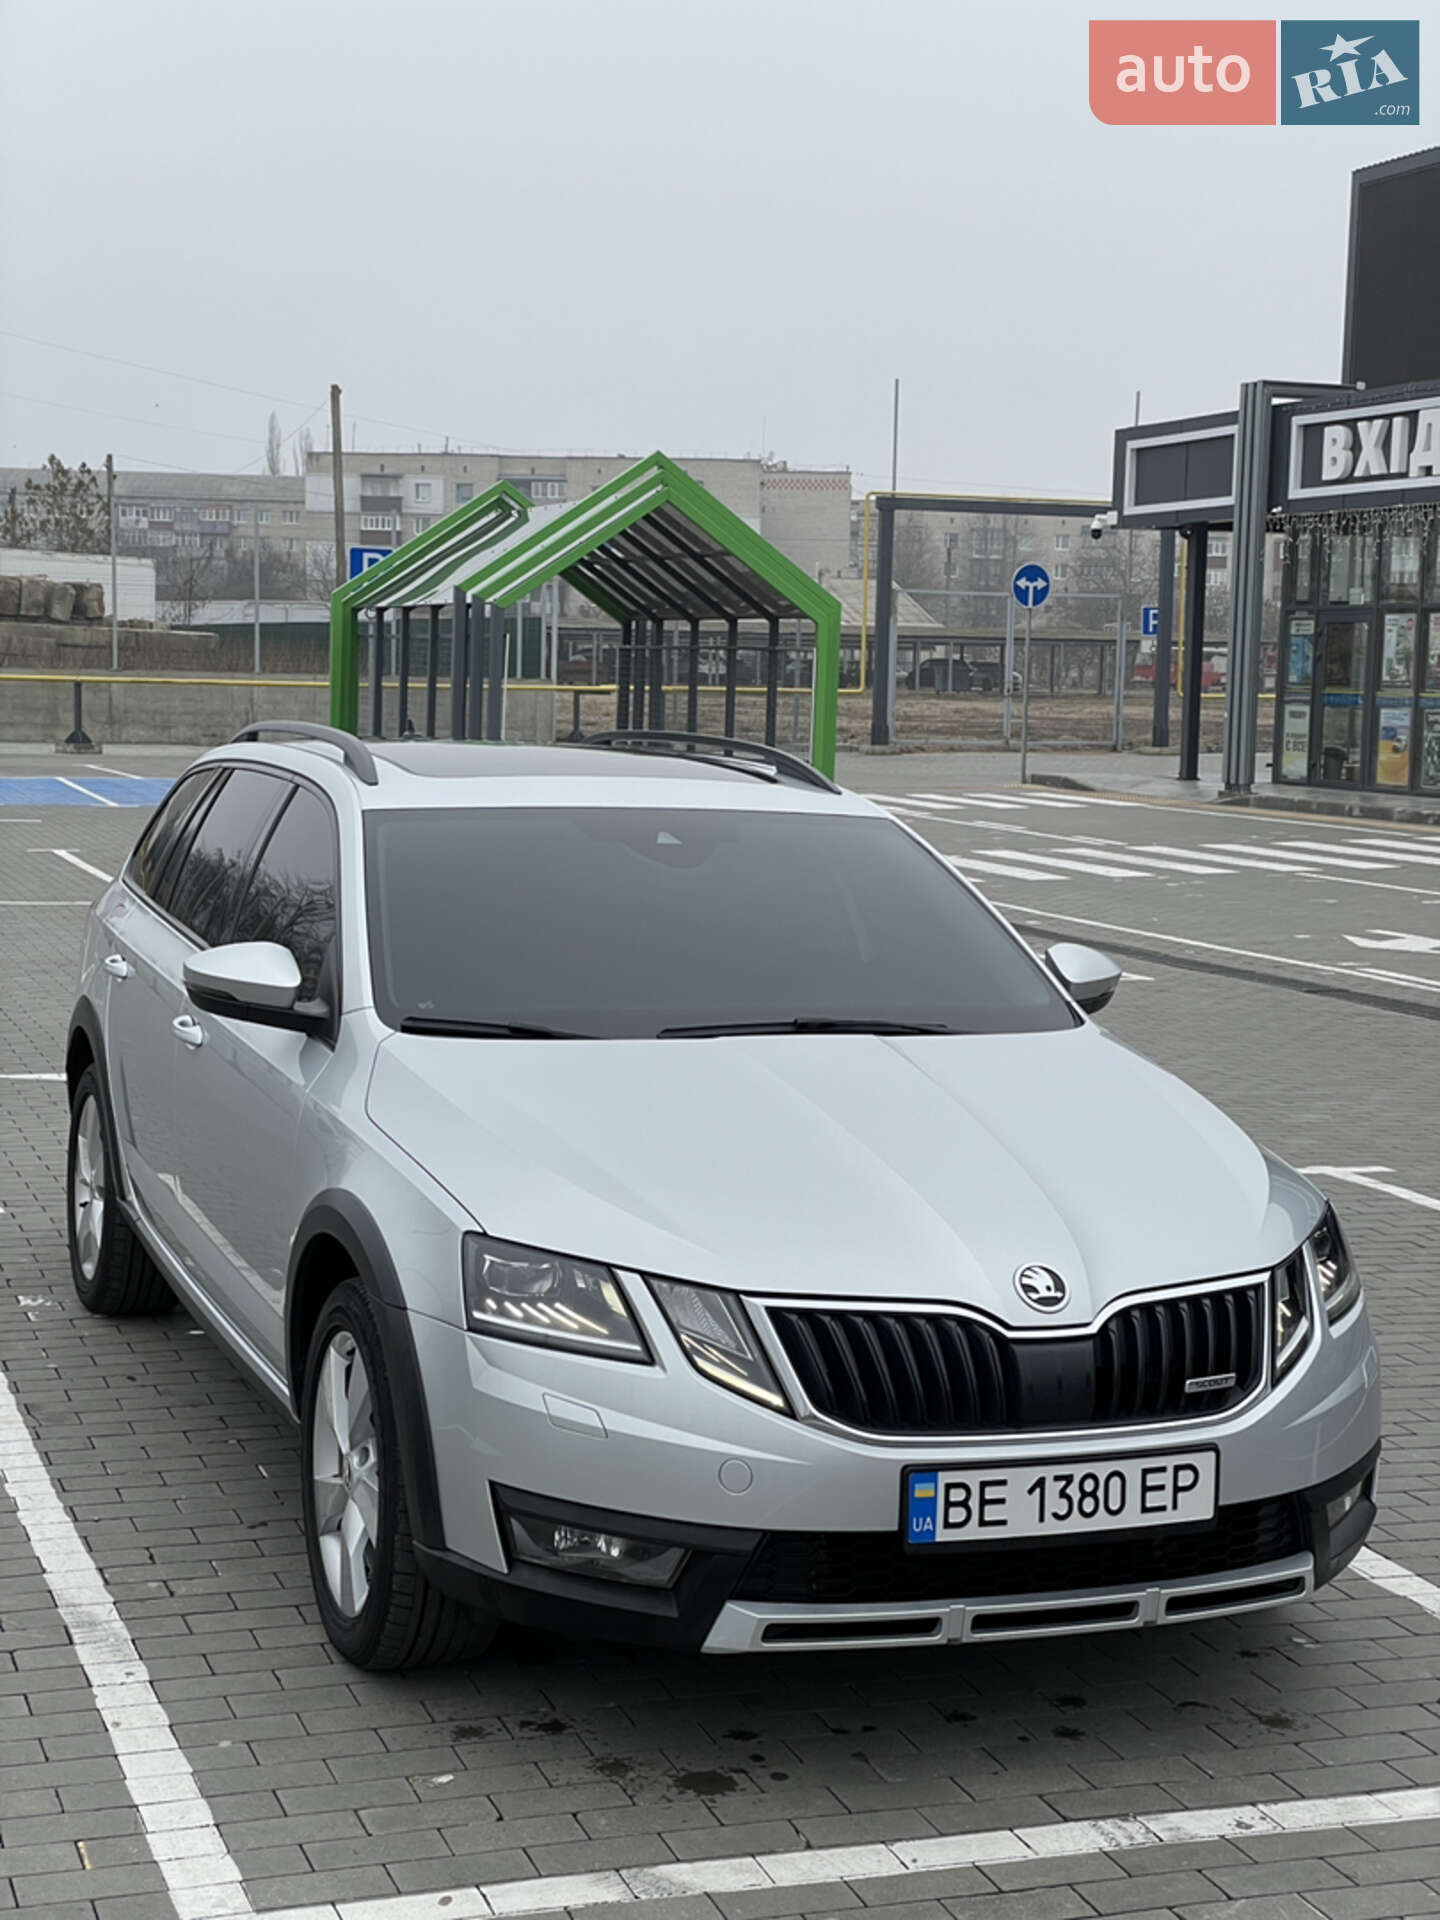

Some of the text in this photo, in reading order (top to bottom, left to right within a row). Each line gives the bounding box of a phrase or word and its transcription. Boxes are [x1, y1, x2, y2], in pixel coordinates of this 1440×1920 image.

[942, 1462, 1201, 1530] BE 1380 EP
[912, 1516, 934, 1533] UA
